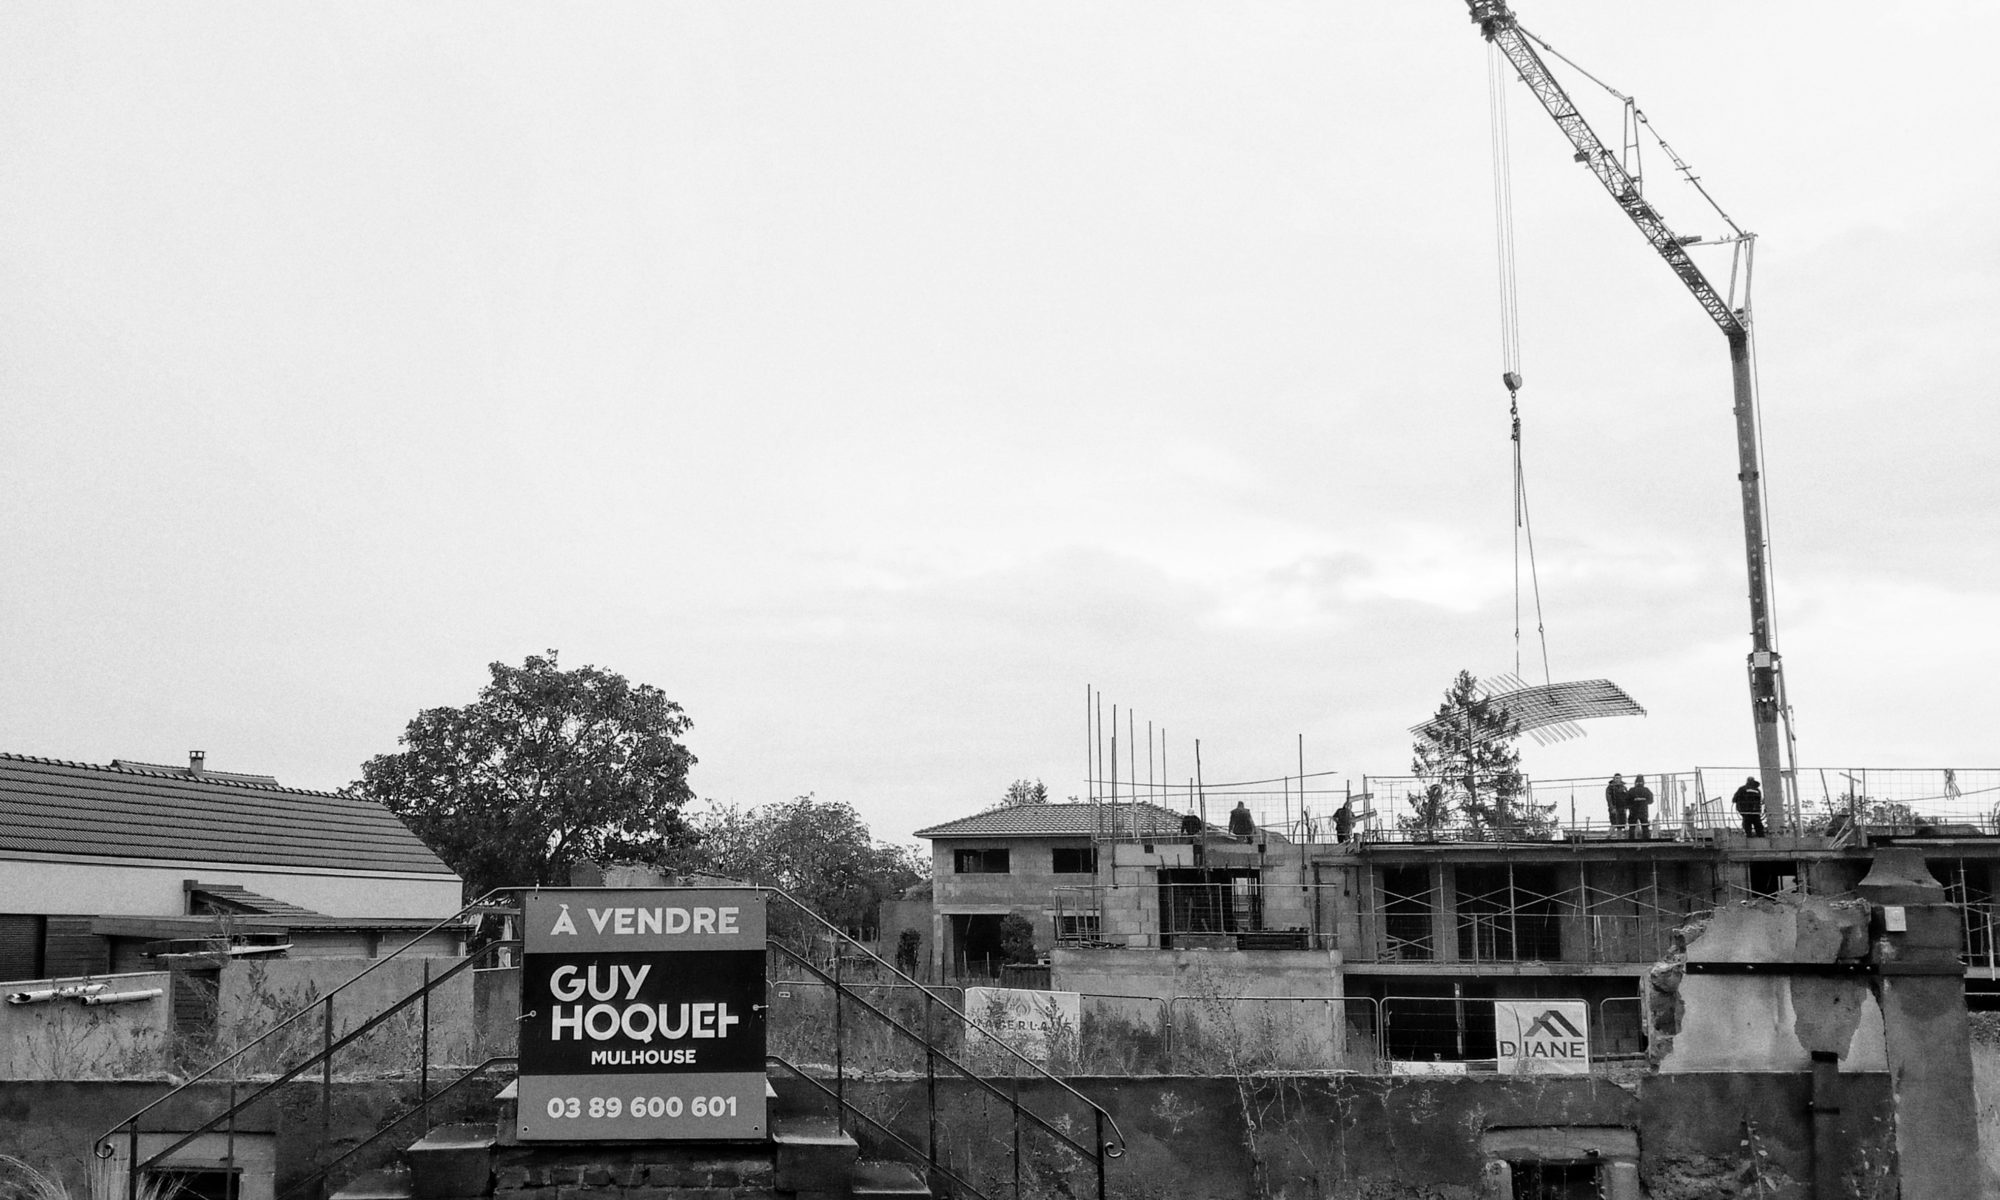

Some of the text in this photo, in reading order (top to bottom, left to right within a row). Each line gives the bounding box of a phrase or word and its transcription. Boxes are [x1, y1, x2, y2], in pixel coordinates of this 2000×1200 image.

[550, 904, 739, 935] À VENDRE
[550, 964, 652, 1001] GUY
[591, 1049, 697, 1065] MULHOUSE
[1499, 1040, 1586, 1058] DIANE
[547, 1096, 737, 1118] 03 89 600 601
